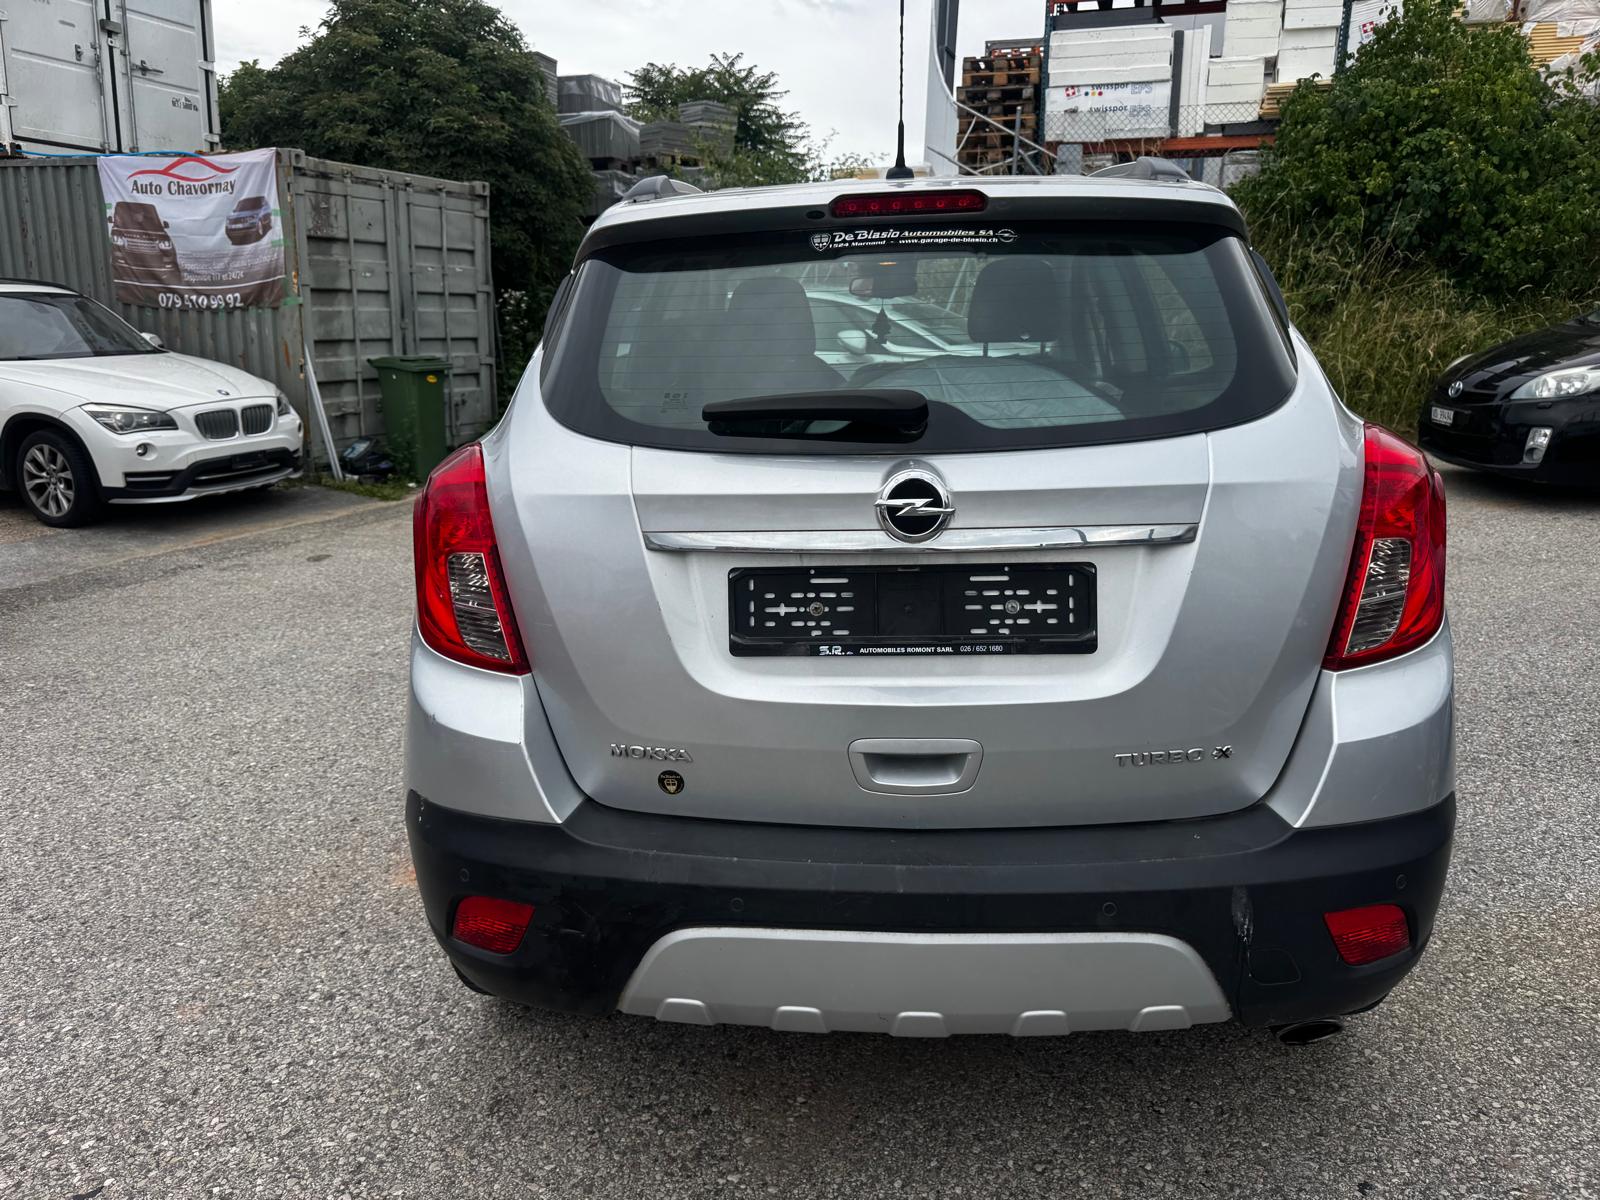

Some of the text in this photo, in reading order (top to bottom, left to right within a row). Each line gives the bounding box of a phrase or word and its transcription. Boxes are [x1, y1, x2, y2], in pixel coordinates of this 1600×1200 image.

[1091, 83, 1129, 91] swisspor
[1089, 104, 1128, 113] swisspor
[131, 179, 236, 196] Auto Chavornay
[833, 228, 994, 243] De Blasio Automobiles SA
[159, 292, 244, 309] 079 410 99 92
[610, 743, 693, 763] MOKKA
[1114, 747, 1204, 767] TURBO
